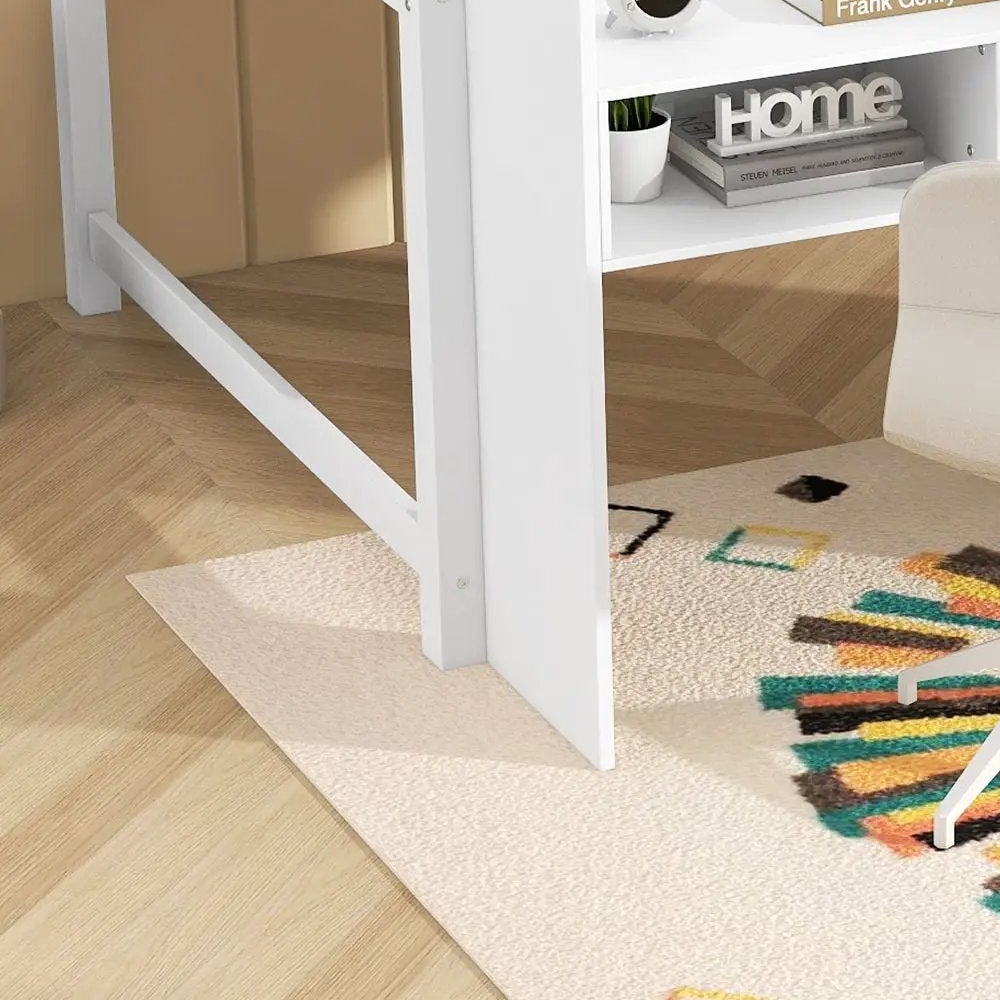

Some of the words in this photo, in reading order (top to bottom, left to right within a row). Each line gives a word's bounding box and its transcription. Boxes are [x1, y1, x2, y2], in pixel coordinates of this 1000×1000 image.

[715, 72, 903, 146] Home
[740, 170, 768, 182] STEVEN
[771, 166, 798, 177] MEISEL
